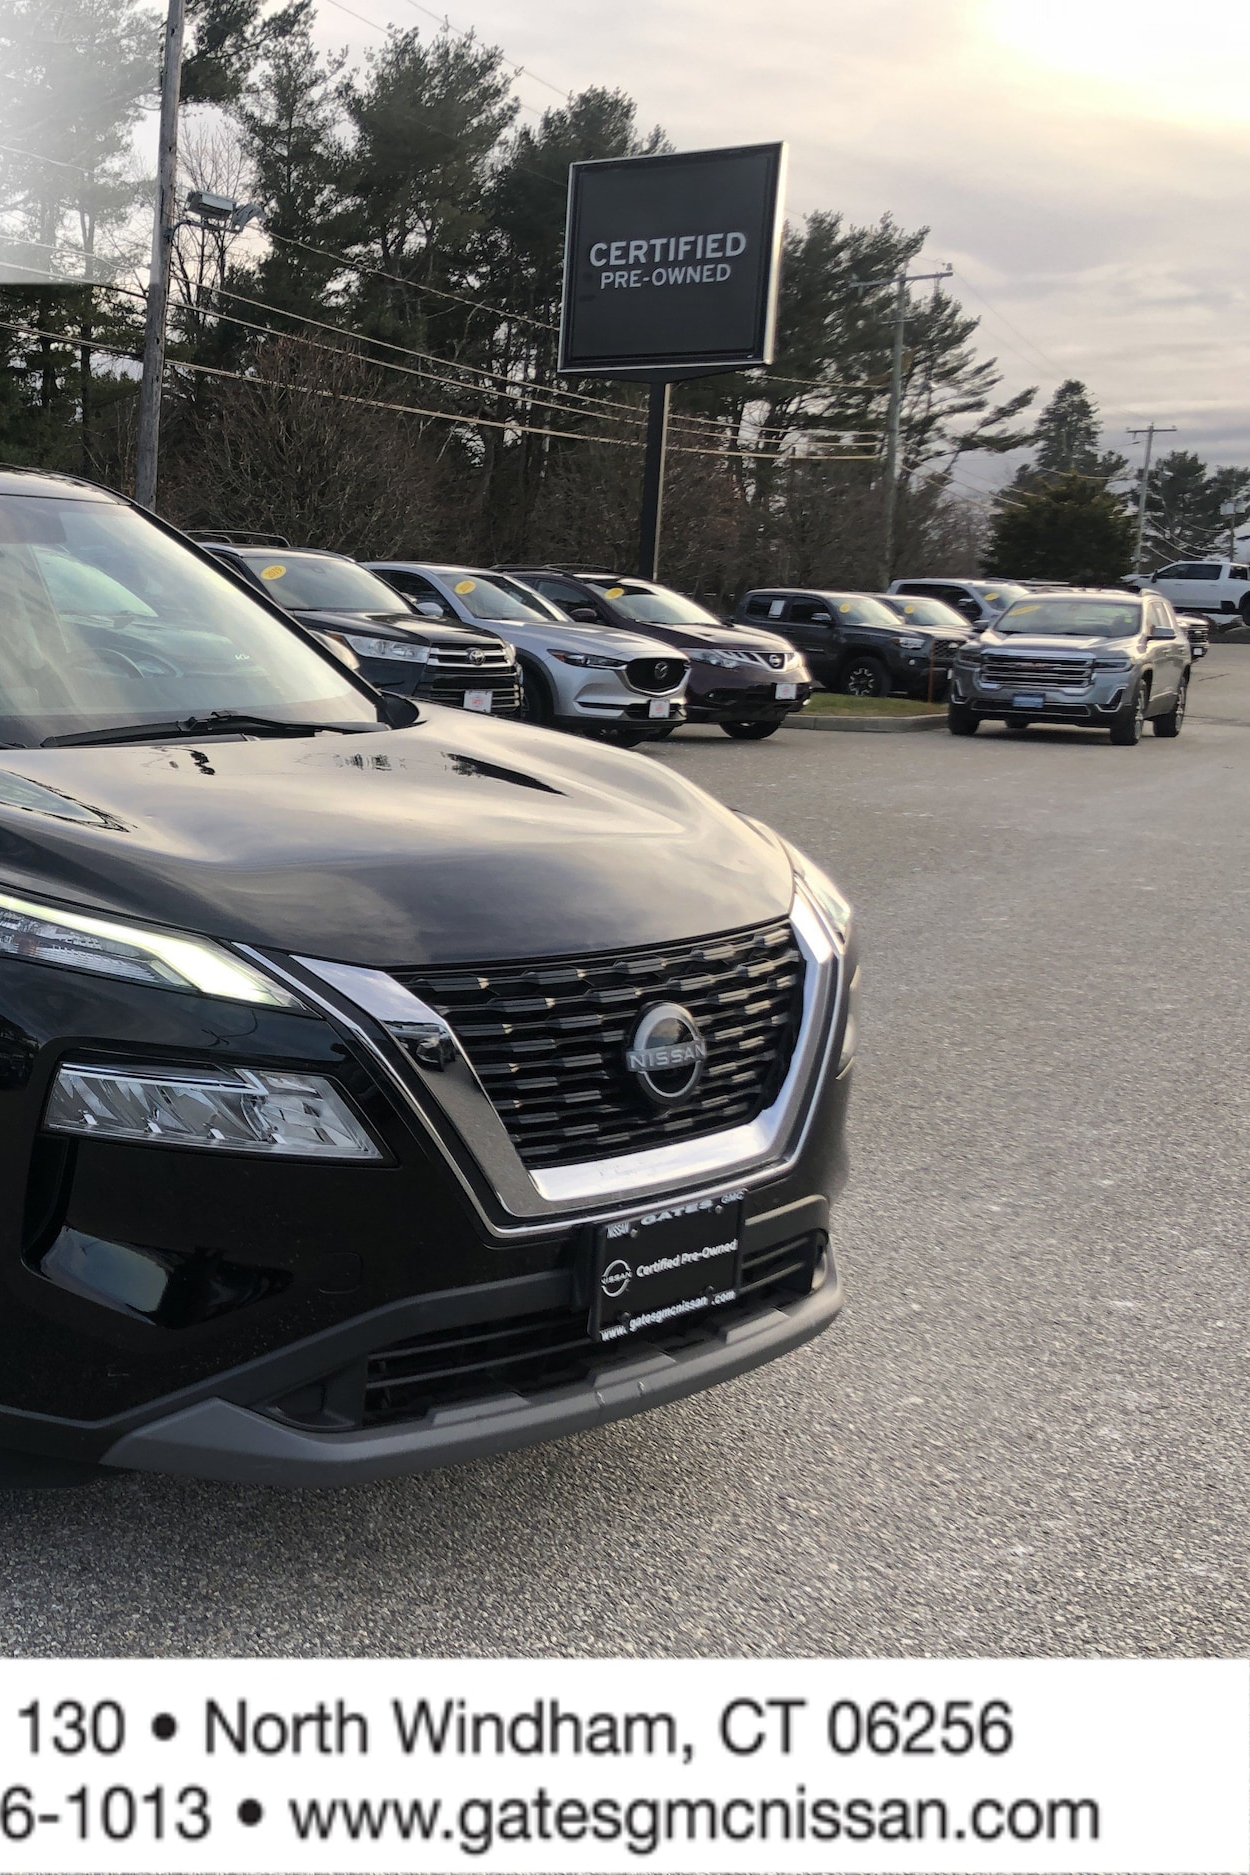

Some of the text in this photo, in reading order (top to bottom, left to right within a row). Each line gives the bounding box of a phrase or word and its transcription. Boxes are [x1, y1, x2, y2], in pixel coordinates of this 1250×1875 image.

[589, 231, 747, 267] CERTIFIED
[600, 263, 732, 290] PRE-OWNED
[629, 1043, 707, 1069] NISSAN
[640, 1199, 714, 1226] GATES
[720, 1191, 745, 1204] GMC
[636, 1239, 739, 1278] Certified Pre-Owned
